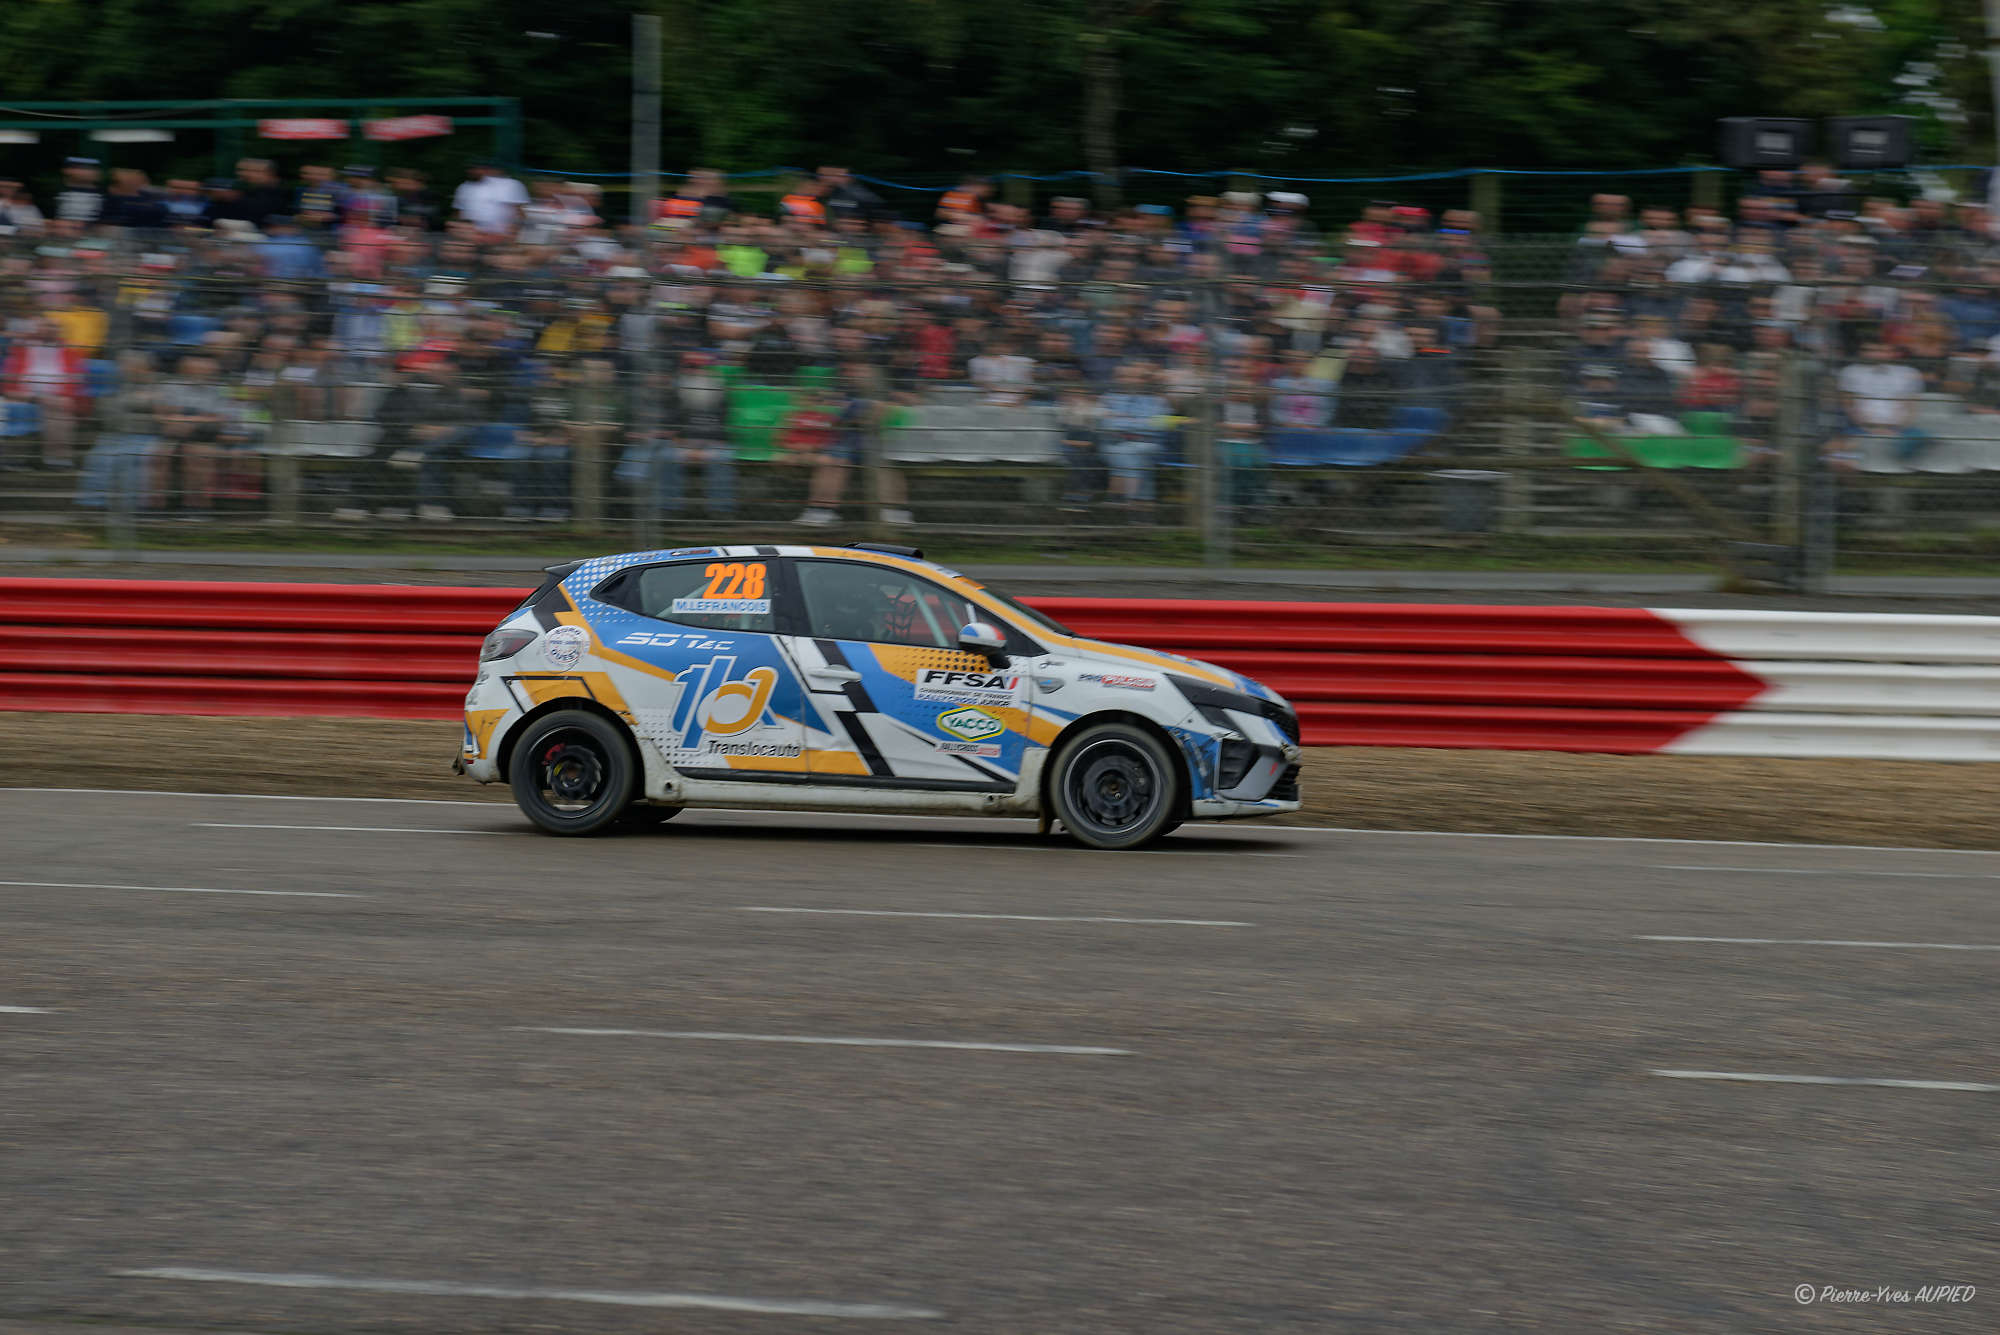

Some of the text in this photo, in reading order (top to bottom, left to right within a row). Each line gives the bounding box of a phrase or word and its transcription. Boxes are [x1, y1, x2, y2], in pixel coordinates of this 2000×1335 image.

[702, 563, 768, 600] 228
[924, 670, 1005, 690] FFSA
[947, 717, 998, 732] YACCO
[707, 740, 802, 757] Translocauto
